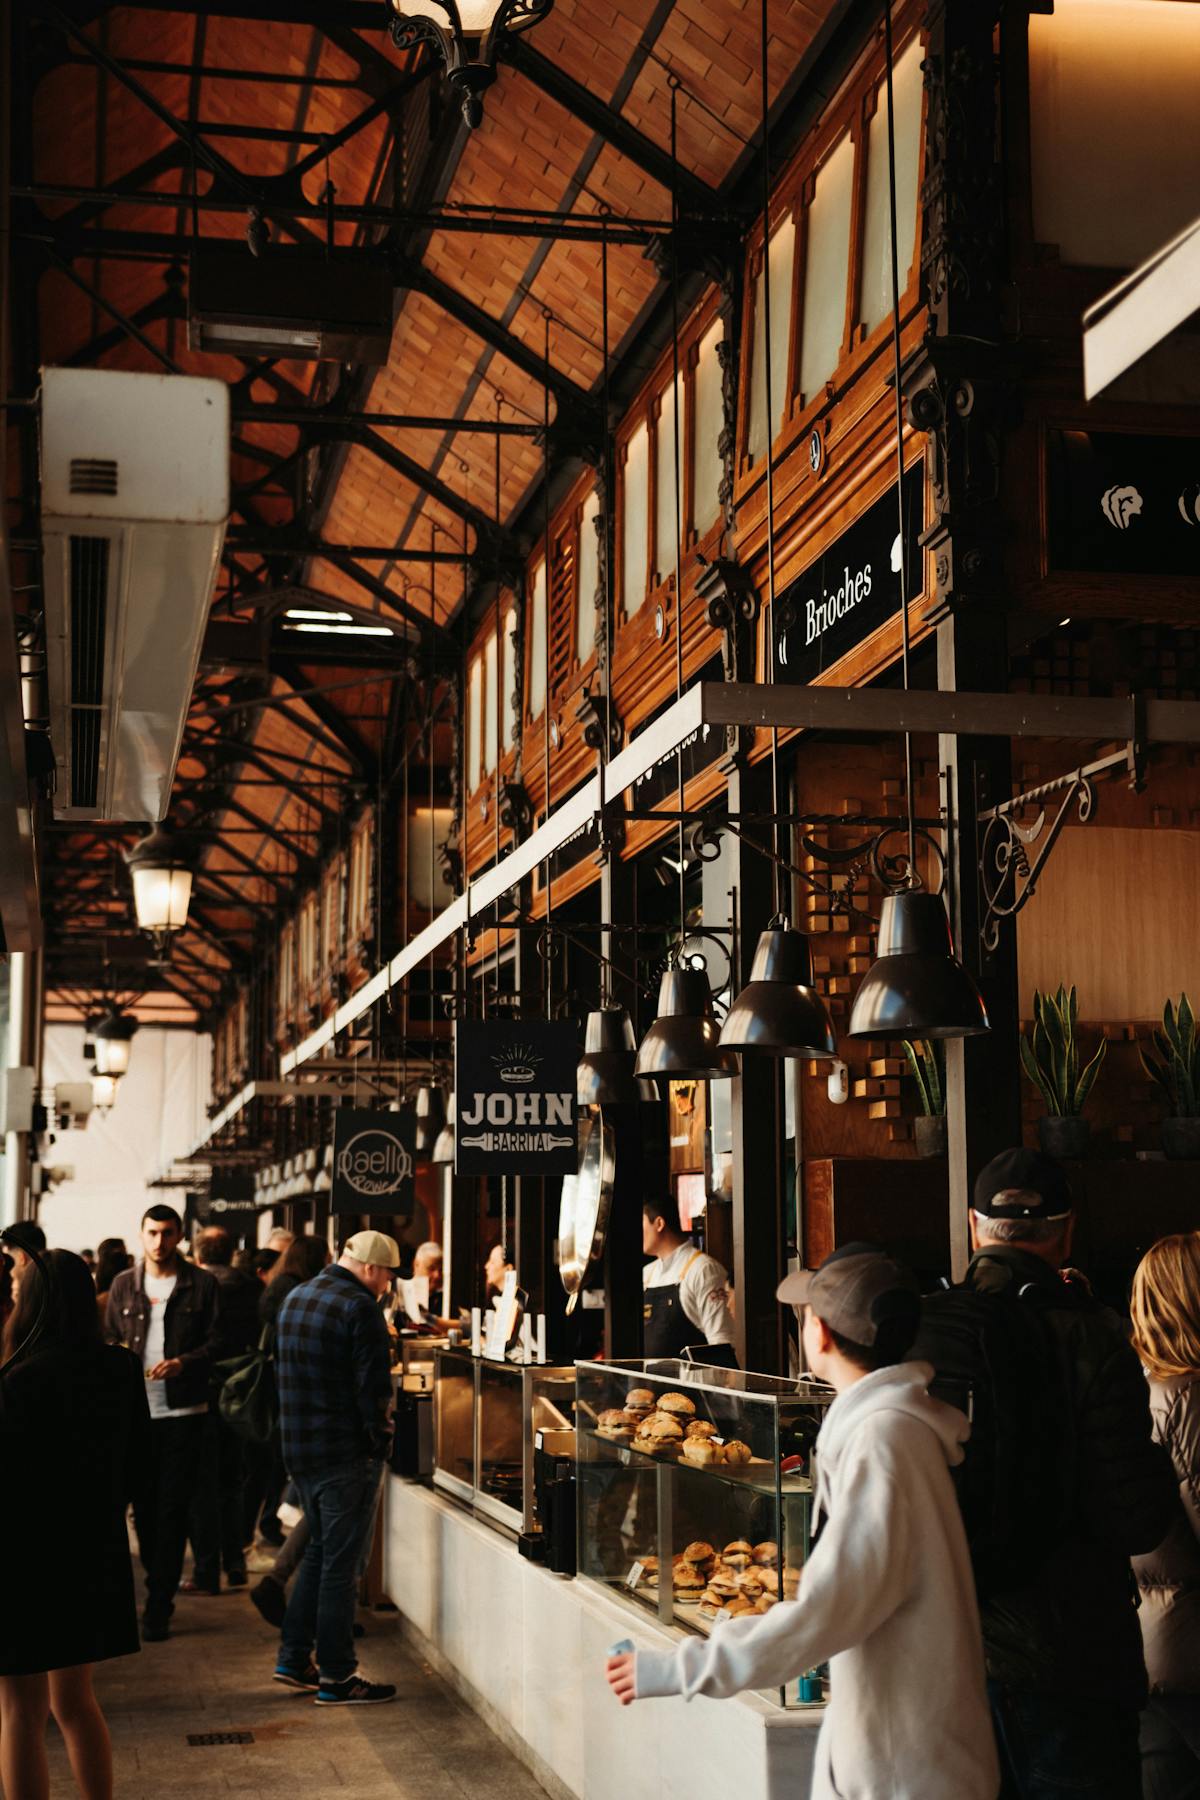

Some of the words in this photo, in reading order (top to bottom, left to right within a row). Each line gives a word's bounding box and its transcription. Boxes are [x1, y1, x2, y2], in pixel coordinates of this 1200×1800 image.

[805, 563, 872, 646] Brioches
[461, 1092, 573, 1125] JOHN
[492, 1133, 545, 1151] BARRITA
[337, 1145, 413, 1178] paella
